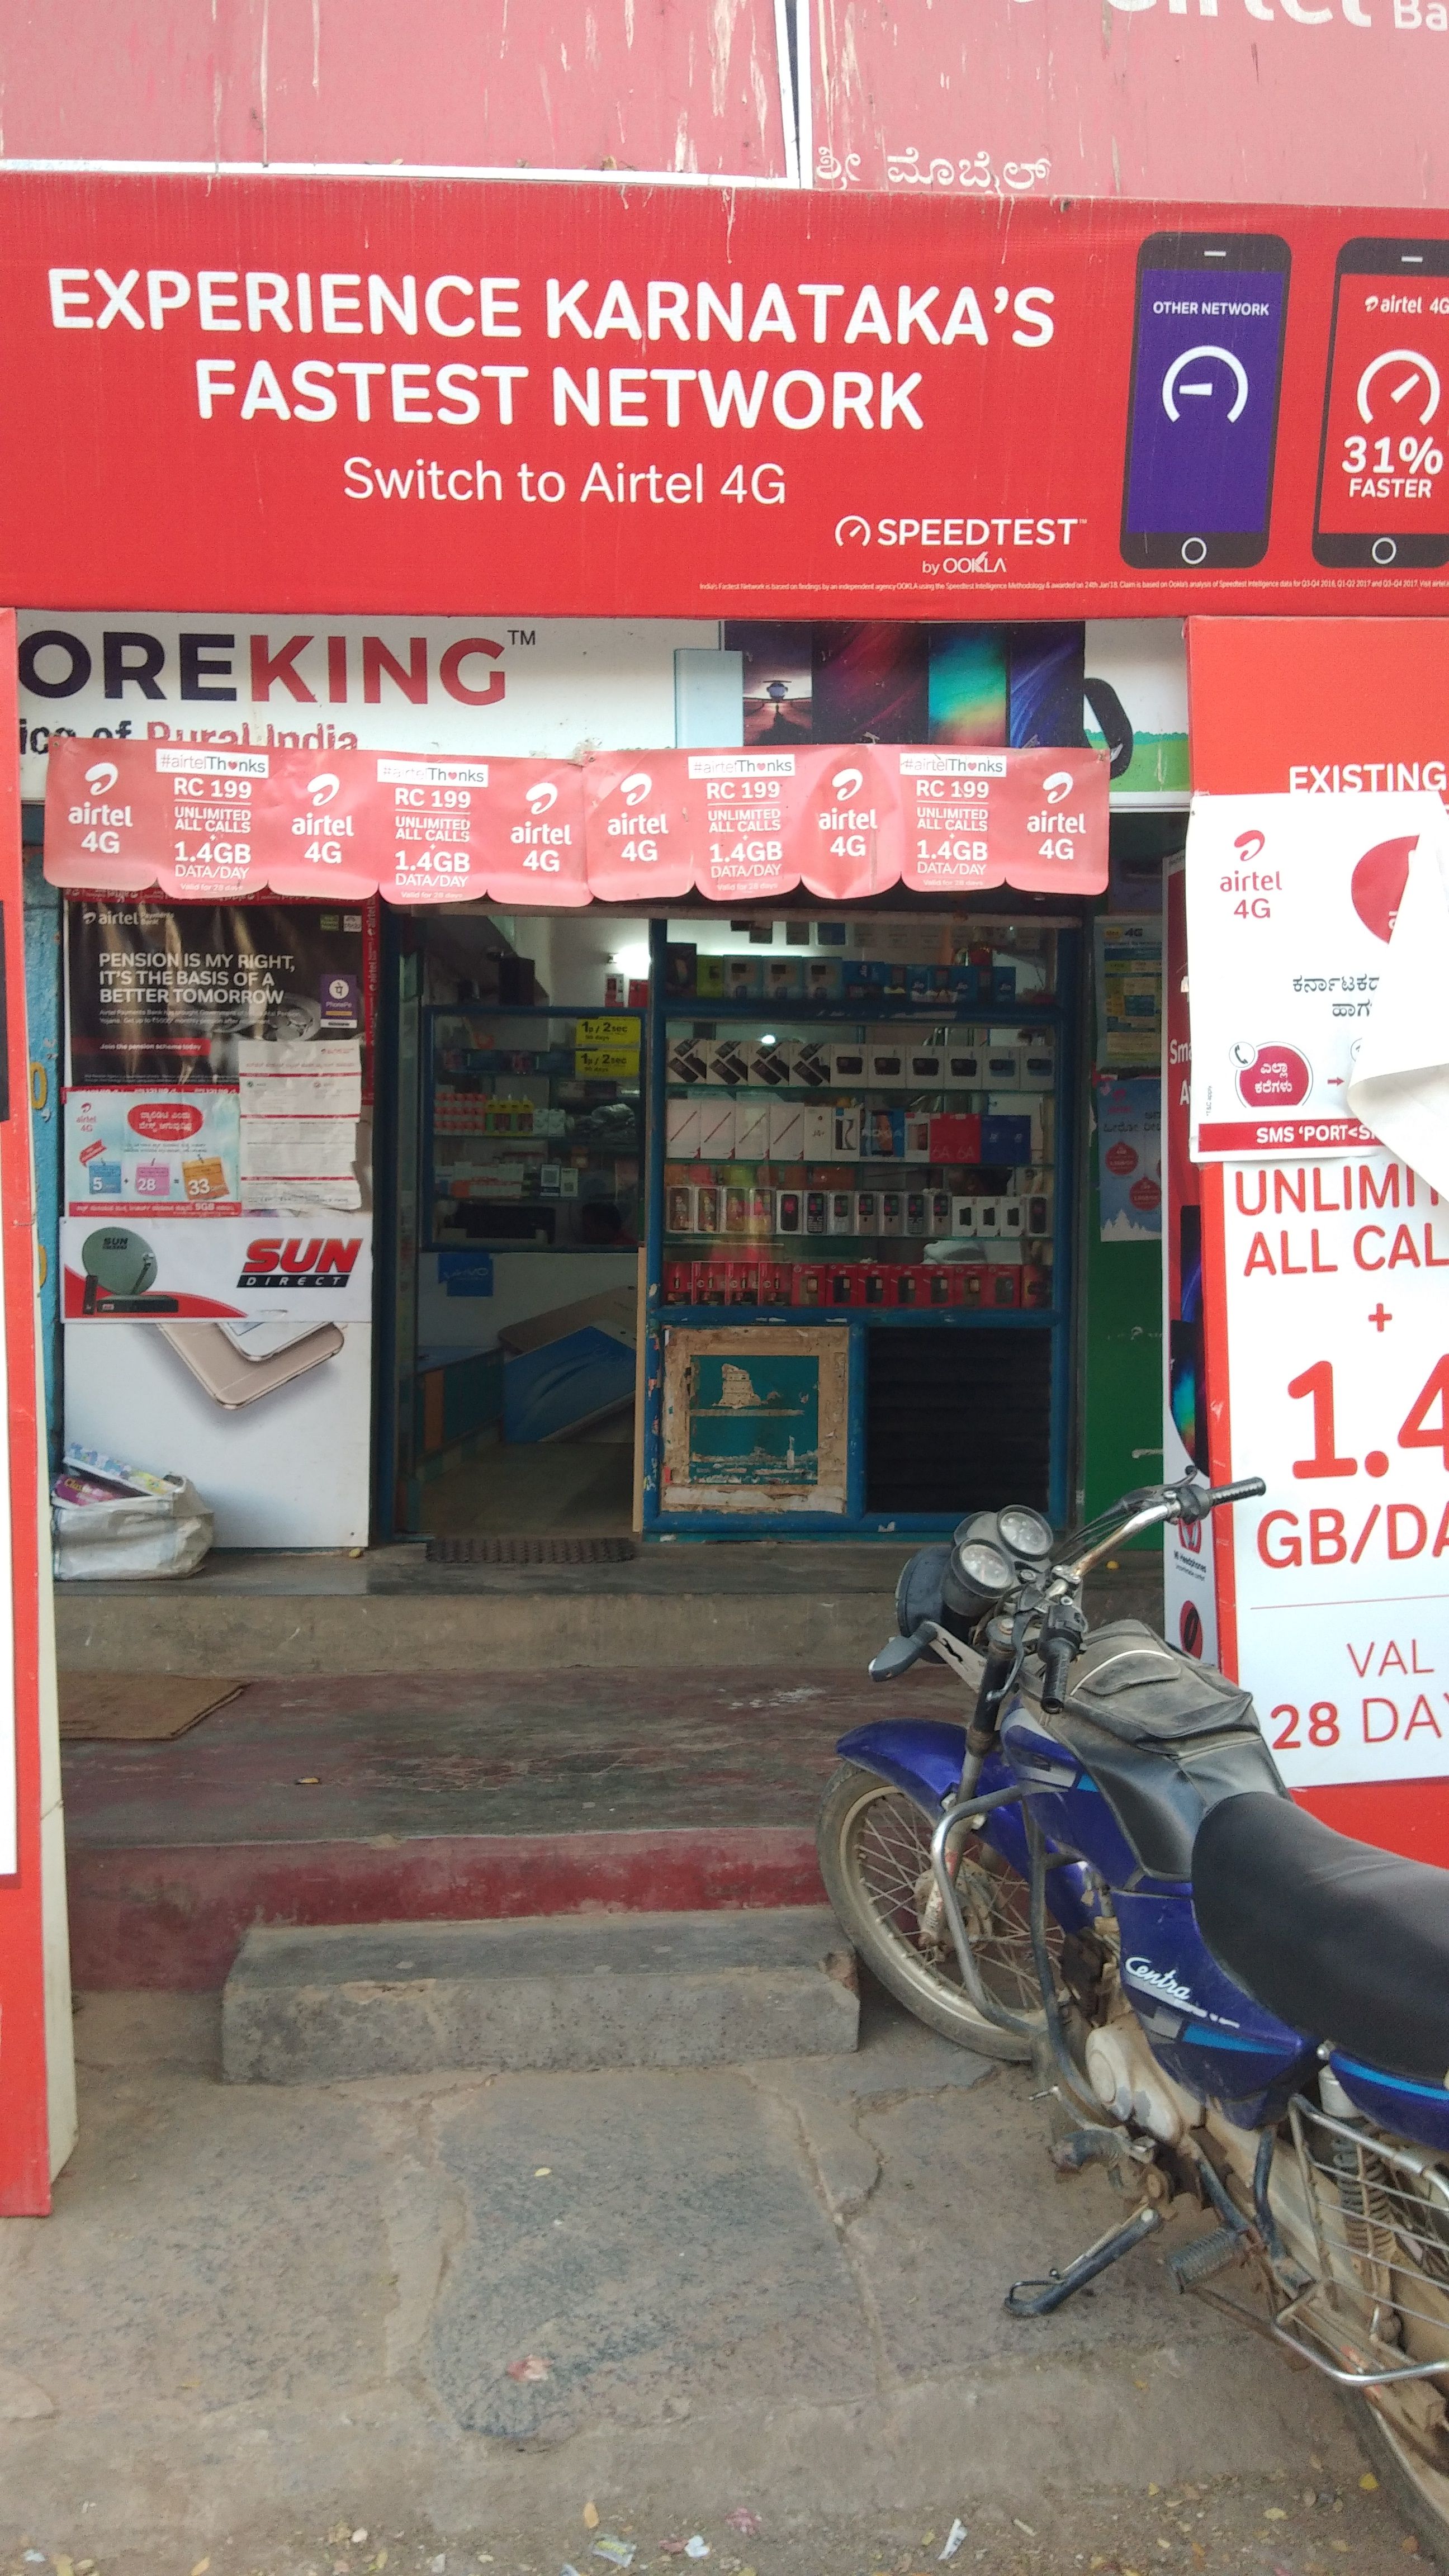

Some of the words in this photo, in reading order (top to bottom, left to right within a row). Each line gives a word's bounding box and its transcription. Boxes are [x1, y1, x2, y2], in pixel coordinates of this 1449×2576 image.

[48, 268, 522, 338] EXPERIENCE
[546, 278, 1054, 347] KARNATAKA'S
[1153, 301, 1199, 315] OTHER
[1201, 302, 1269, 316] NETWORK
[1380, 294, 1422, 314] airtel
[1429, 298, 1449, 316] 4G
[196, 359, 529, 425] FASTEST
[553, 367, 924, 430] NETWORK
[1342, 435, 1443, 475] 31%
[344, 457, 502, 501] Switch
[517, 463, 565, 503] to
[580, 462, 703, 504] Airtel
[720, 463, 785, 504] 4G
[1349, 478, 1432, 498] FASTER
[877, 518, 1078, 546] SPEEDTEST
[922, 560, 940, 576] by
[943, 551, 1007, 574] OOKLA
[17, 627, 508, 708] OREKING
[1289, 760, 1448, 793] EXISTING
[174, 777, 204, 797] RC
[211, 780, 252, 799] 199
[395, 787, 425, 807] RC
[431, 790, 471, 808] 199
[707, 782, 735, 799] RC
[741, 780, 780, 799] 199
[916, 779, 944, 798] RC
[951, 780, 989, 798] 199
[68, 801, 133, 827] airtel
[174, 806, 252, 822] UNLIMITED
[291, 812, 354, 837] airtel
[395, 816, 471, 831] UNLIMITED
[607, 812, 669, 836] airtel
[708, 808, 782, 821] UNLIMITED
[818, 807, 878, 830] airtel
[917, 807, 988, 820] UNLIMITED
[1026, 810, 1086, 834] airtel
[174, 818, 202, 831] ALL
[205, 820, 251, 834] CALLS
[395, 827, 423, 840] ALL
[425, 829, 471, 842] CALLS
[510, 821, 572, 845] airtel
[709, 821, 735, 833] ALL
[737, 820, 781, 832] CALLS
[917, 818, 943, 830] ALL
[945, 819, 988, 832] CALLS
[81, 831, 120, 854] 4G
[175, 841, 251, 864] 1.4GB
[304, 841, 342, 864] 4G
[621, 840, 658, 861] 4G
[709, 841, 783, 863] 1.4GB
[830, 835, 866, 857] 4G
[917, 840, 988, 861] 1.4GB
[1038, 838, 1074, 860] 4G
[395, 850, 470, 873] 1.4GB
[523, 849, 560, 872] 4G
[711, 864, 782, 878] DATA/DAY
[917, 861, 987, 875] DATA/DAY
[174, 864, 249, 880] DATA/DAY
[395, 873, 469, 888] DATA/DAY
[1220, 870, 1282, 892] airtel
[98, 911, 139, 925] airtel
[1233, 898, 1271, 919] 4G
[98, 951, 181, 968] PENSION
[184, 953, 201, 968] IS
[205, 954, 233, 968] MY
[238, 954, 296, 973] RIGHT,
[99, 970, 132, 986] IT'S
[136, 970, 173, 986] THE
[176, 971, 229, 986] BASIS
[233, 972, 258, 987] OF
[262, 972, 275, 987] A
[99, 988, 169, 1003] BETTER
[172, 988, 285, 1005] TOMORROW
[1332, 999, 1372, 1017] ಹಾಗ
[1256, 1126, 1295, 1144] SMS
[1298, 1123, 1376, 1144] 'PORT<S
[92, 1177, 103, 1190] 5
[138, 1178, 157, 1191] 28
[188, 1178, 211, 1195] 33
[103, 1237, 129, 1246] SUN
[1243, 1228, 1338, 1277] ALL
[242, 1237, 363, 1273] SUN
[246, 1277, 341, 1286] DIRECT
[1288, 1353, 1449, 1479] 1.4
[1270, 1701, 1340, 1750] 28
[1361, 1692, 1449, 1744] DA
[1125, 1957, 1192, 2000] Centra
